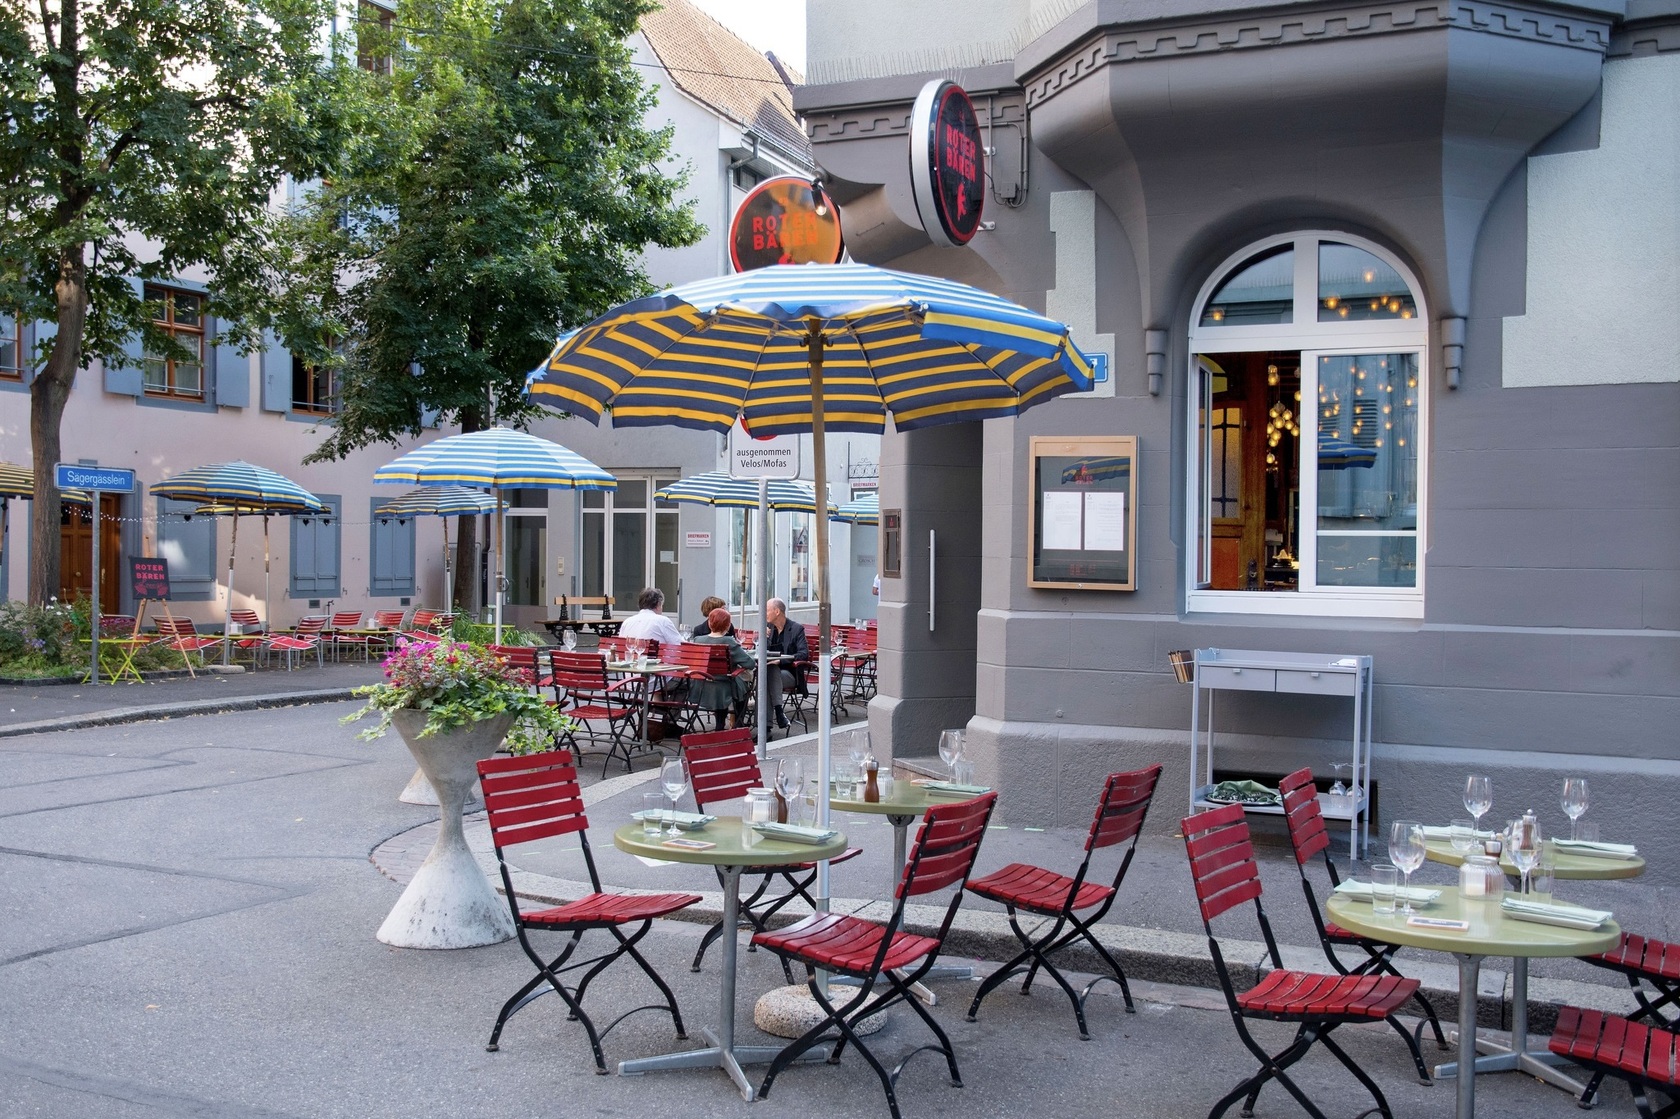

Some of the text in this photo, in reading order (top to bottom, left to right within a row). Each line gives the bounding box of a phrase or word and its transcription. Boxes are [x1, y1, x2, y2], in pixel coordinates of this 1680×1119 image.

[946, 123, 976, 161] ROTER
[946, 146, 976, 183] BÄREN
[752, 211, 817, 233] ROTER
[753, 230, 818, 251] BÄREN
[736, 449, 792, 458] ausgenommen
[740, 458, 787, 468] Velos/Mofas
[67, 470, 125, 487] Sägergässlein
[135, 563, 164, 572] ROTER
[136, 572, 165, 580] BÄREN
